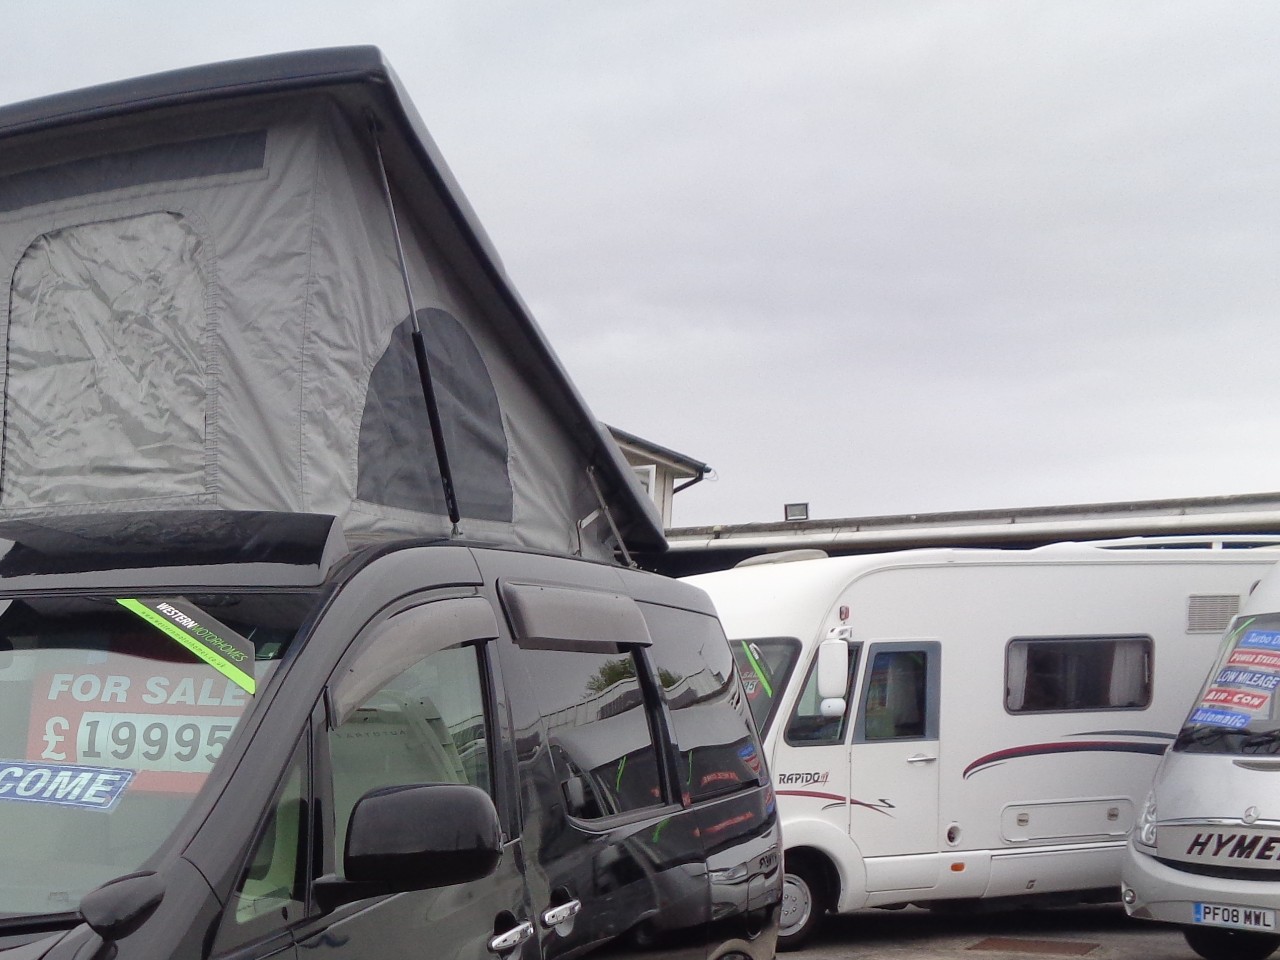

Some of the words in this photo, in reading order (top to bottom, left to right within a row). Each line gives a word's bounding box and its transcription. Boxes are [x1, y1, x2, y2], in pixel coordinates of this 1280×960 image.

[48, 674, 131, 702] FOR
[142, 676, 245, 706] SALE
[1217, 670, 1238, 683] LOW
[1237, 672, 1279, 689] MILEAGE
[1205, 691, 1263, 705] AIR-CON
[1192, 710, 1245, 726] Automatic
[41, 716, 232, 763] £19995
[1186, 833, 1280, 860] HYME
[1203, 905, 1239, 922] PF08
[1244, 910, 1271, 927] MWL
